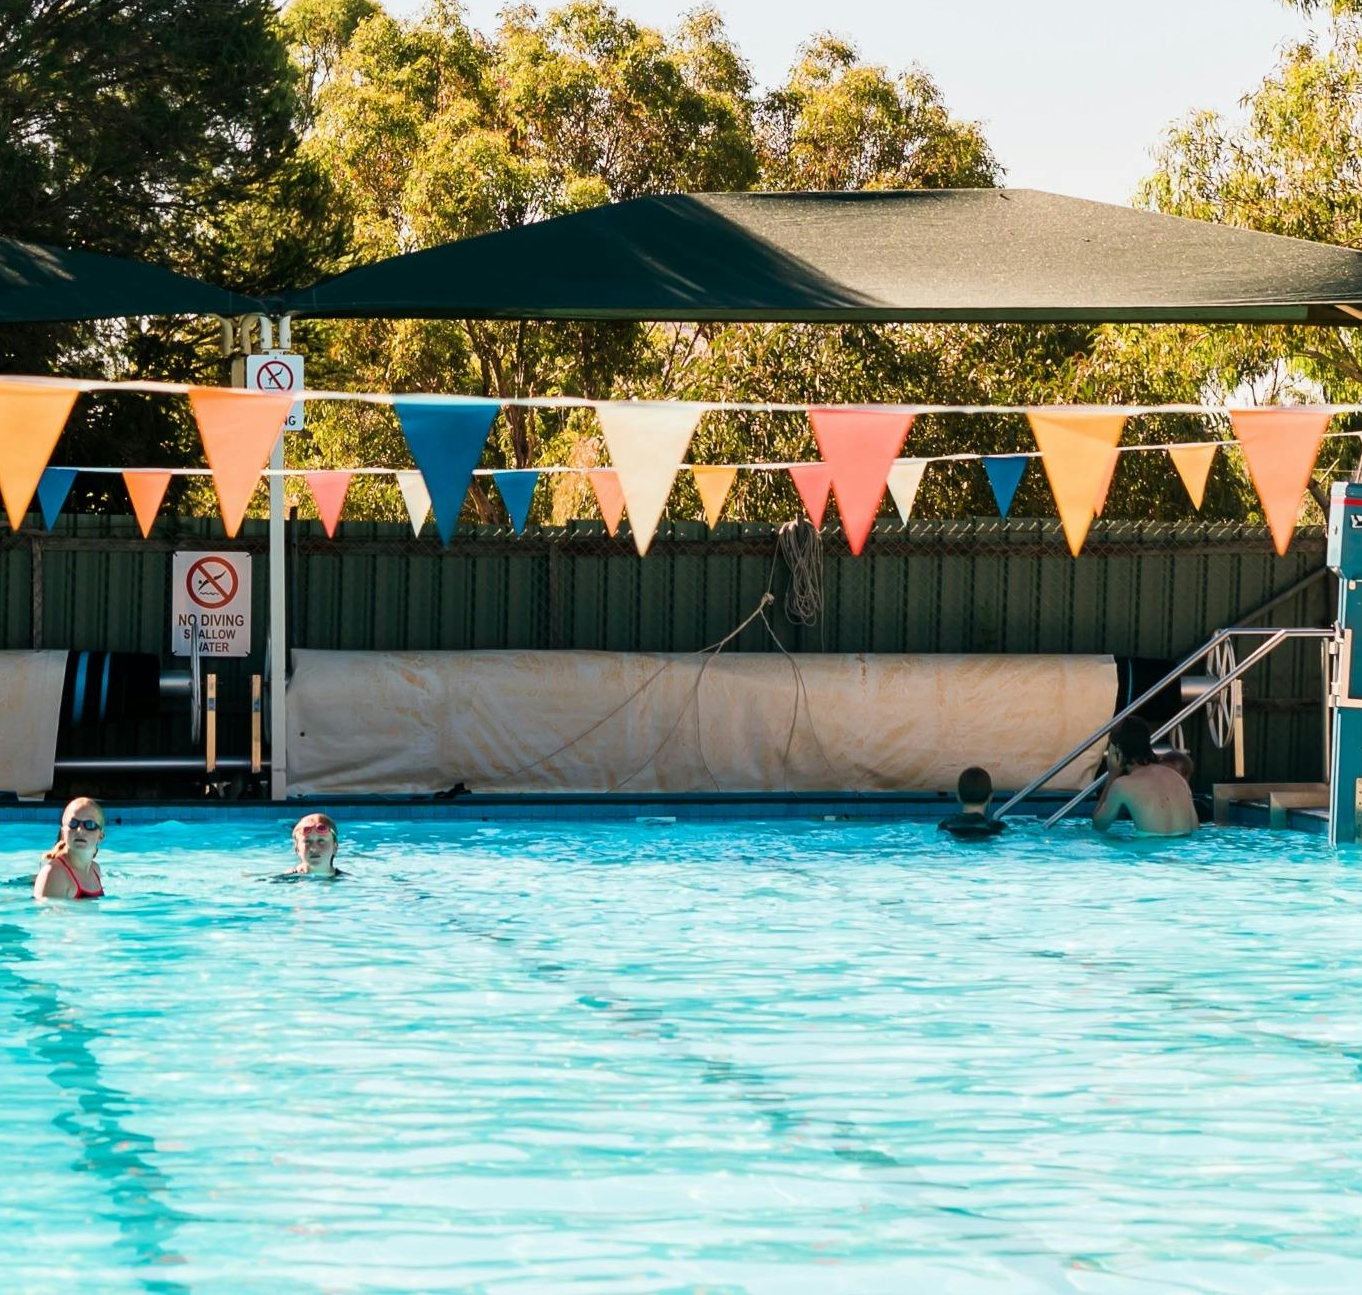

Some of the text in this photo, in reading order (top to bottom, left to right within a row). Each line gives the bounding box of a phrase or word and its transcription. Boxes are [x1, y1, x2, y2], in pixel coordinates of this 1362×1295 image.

[178, 613, 245, 627] NO DIVING
[183, 628, 236, 640] SALLOW
